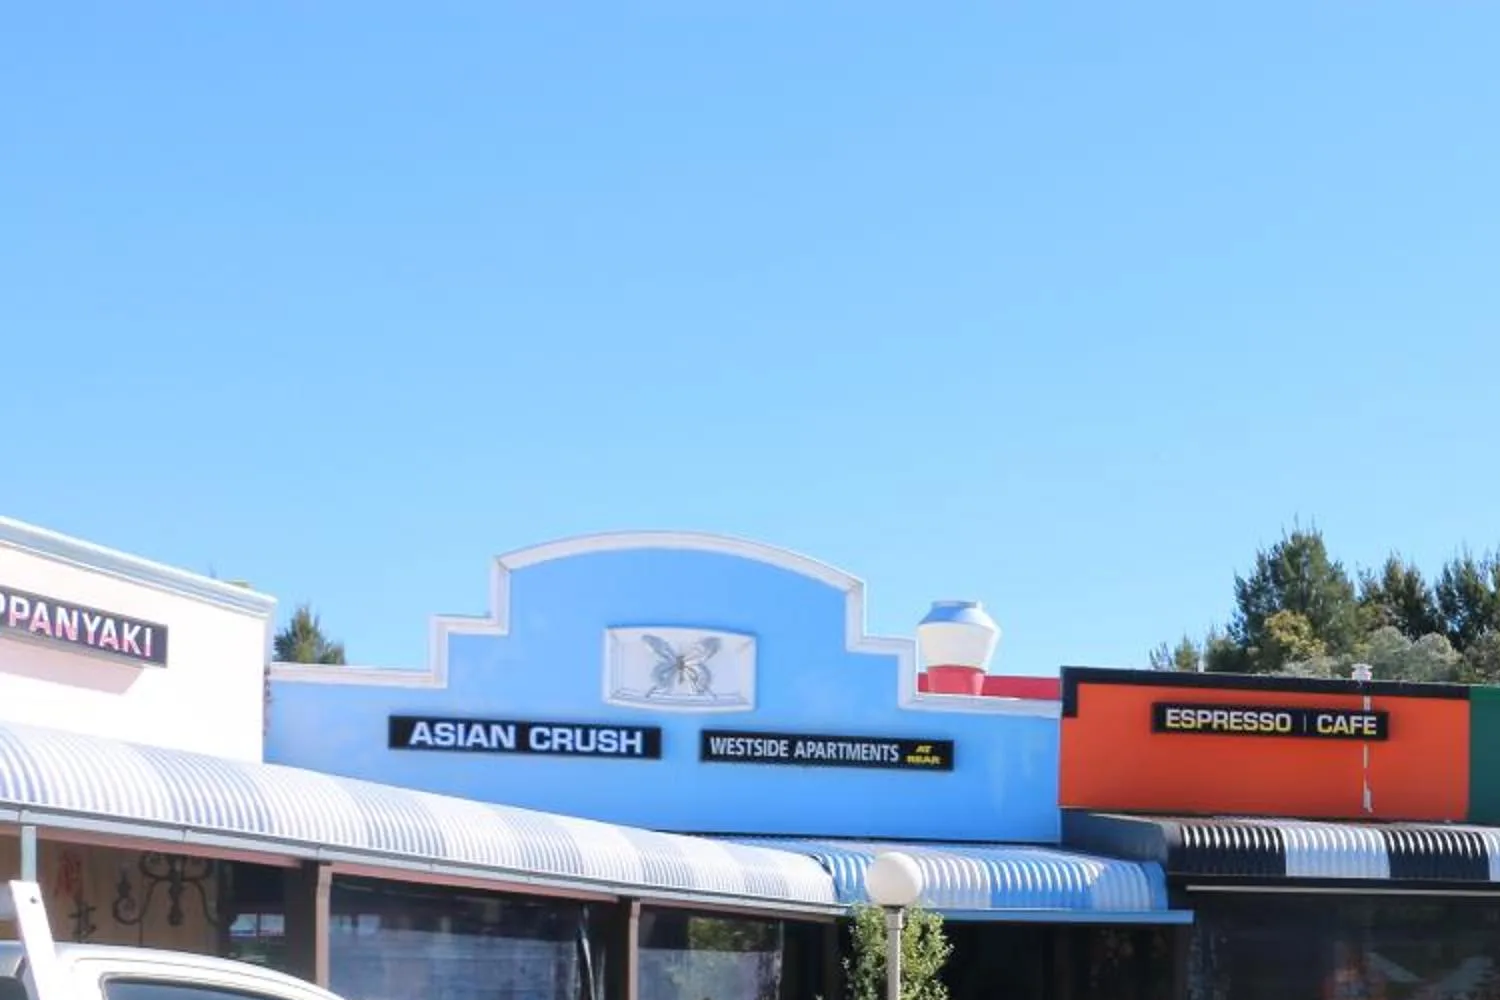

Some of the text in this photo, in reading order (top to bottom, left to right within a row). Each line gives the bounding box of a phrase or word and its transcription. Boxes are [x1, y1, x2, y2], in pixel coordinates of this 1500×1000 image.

[1165, 708, 1377, 735] ESPRESSO CAFE
[409, 721, 642, 754] ASIAN CRUSH
[710, 736, 899, 762] WESTSIDE APARTMENTS
